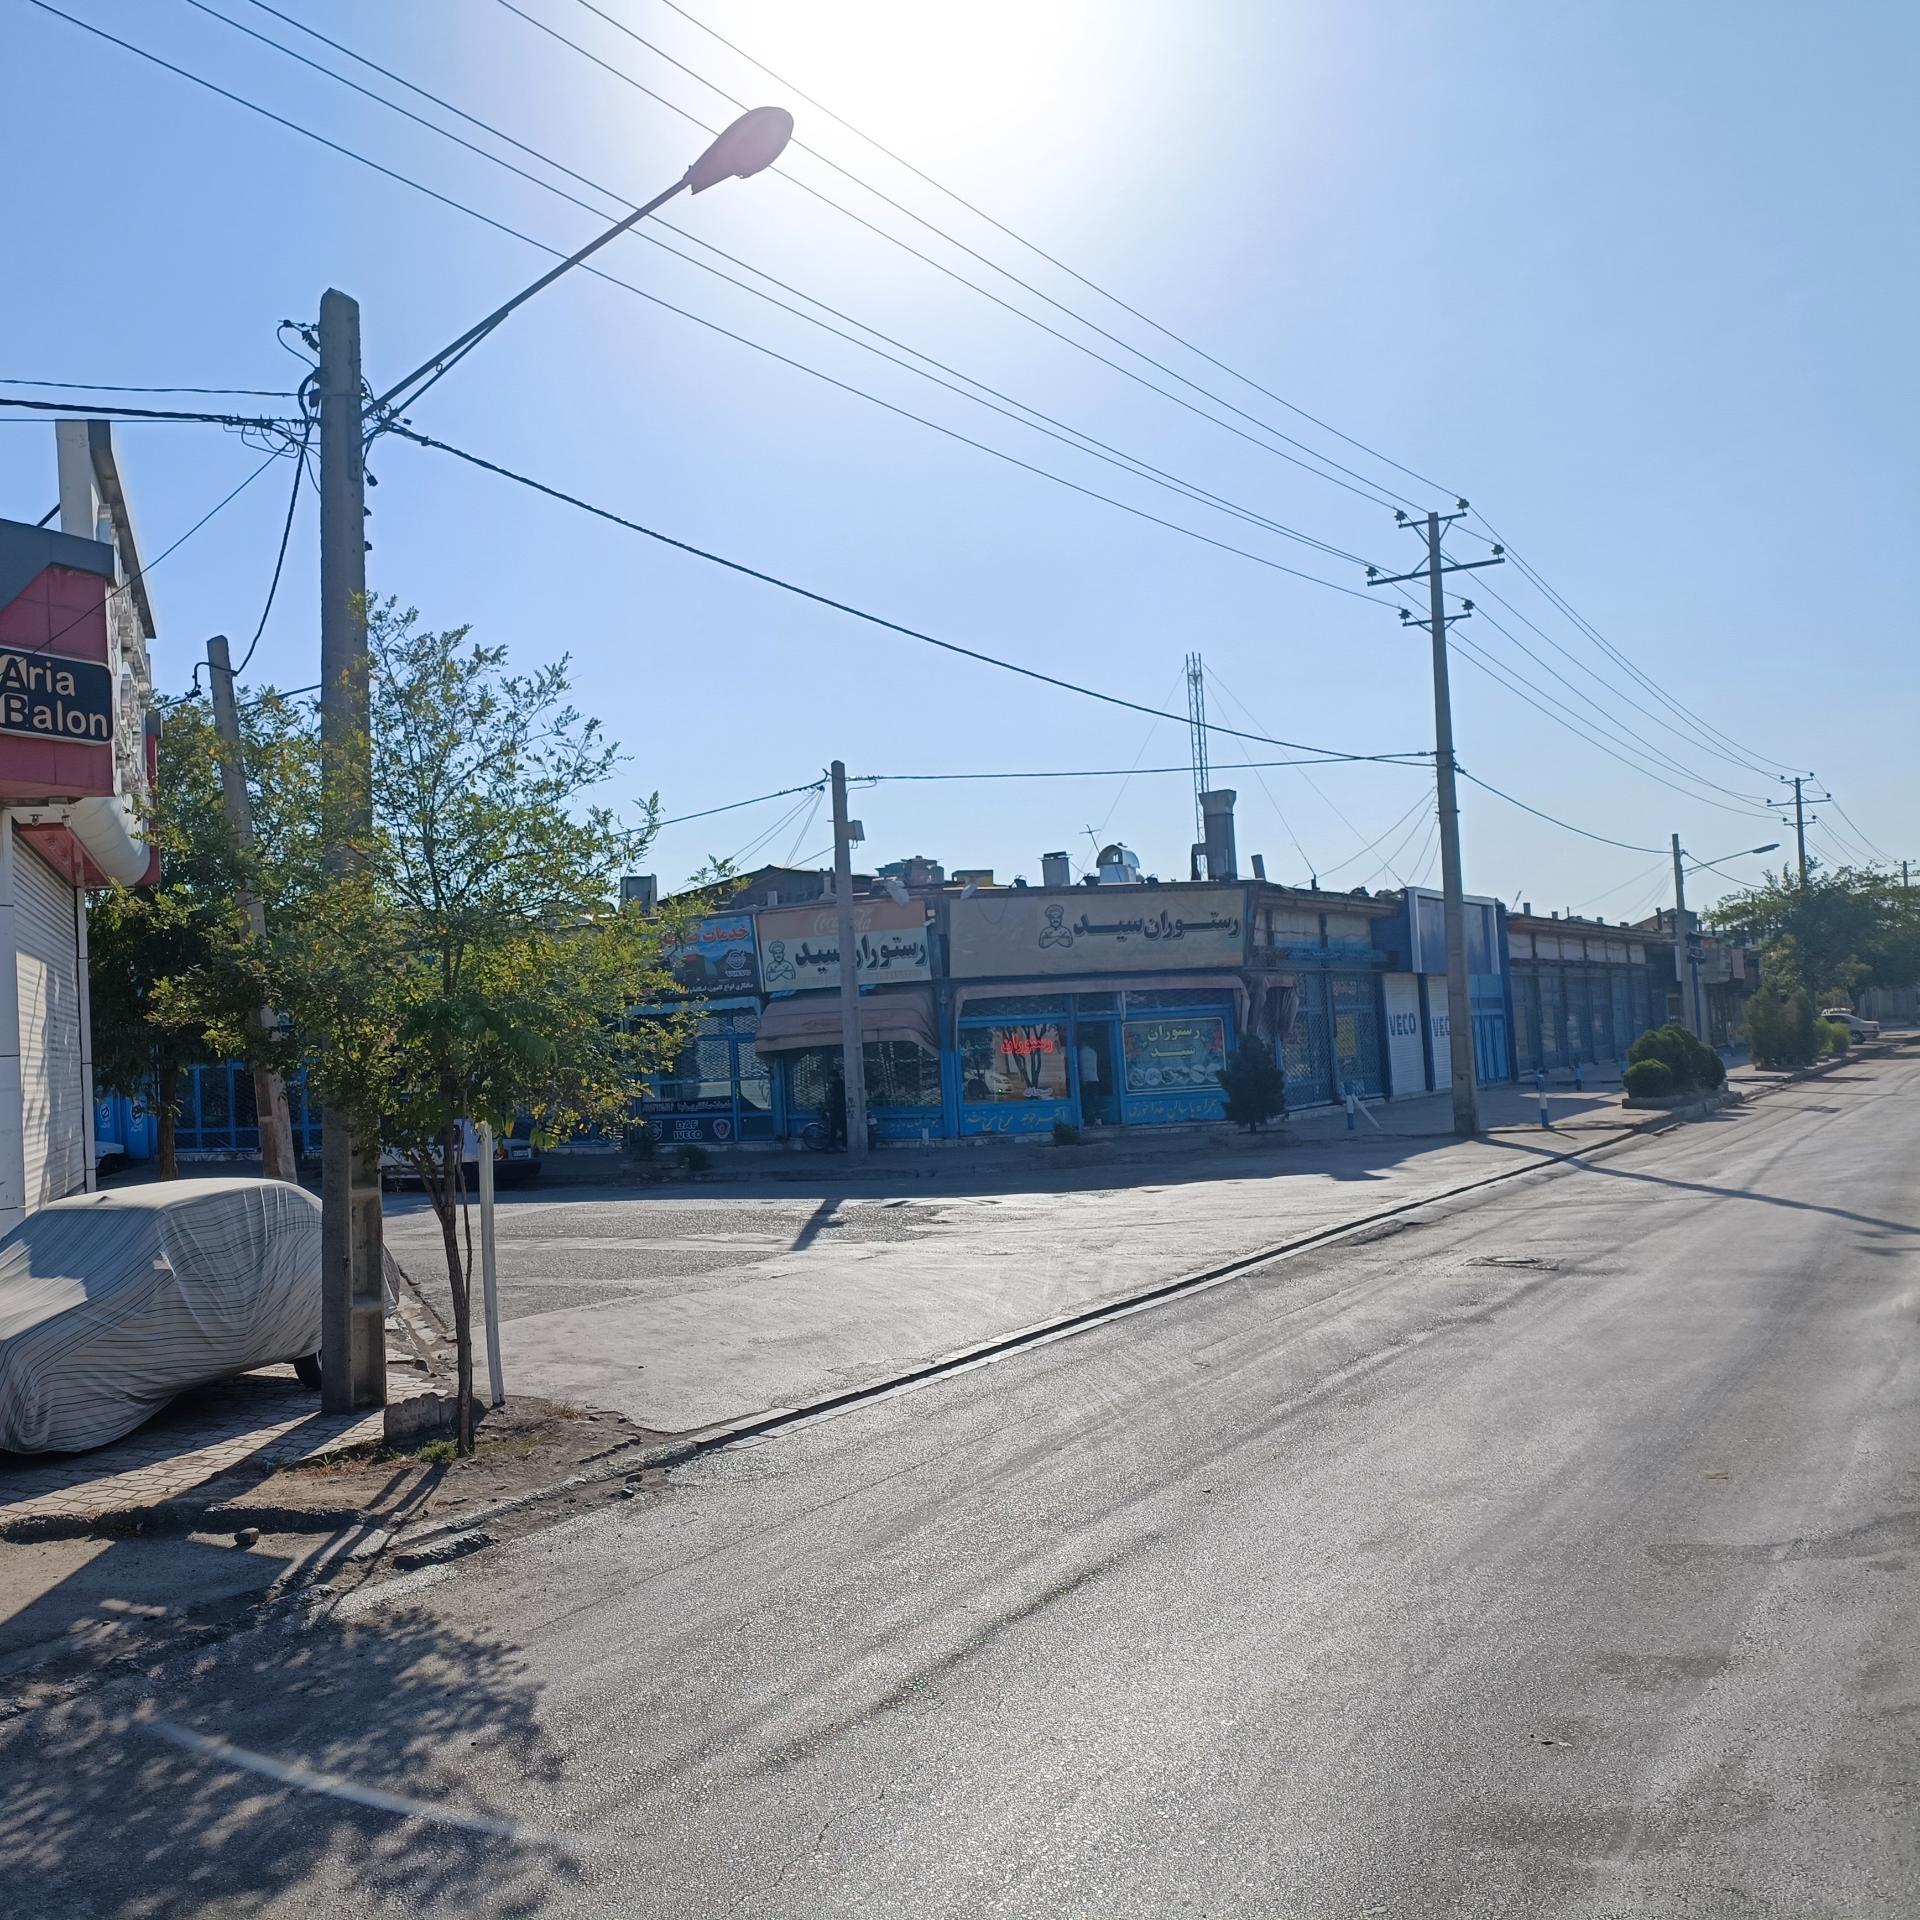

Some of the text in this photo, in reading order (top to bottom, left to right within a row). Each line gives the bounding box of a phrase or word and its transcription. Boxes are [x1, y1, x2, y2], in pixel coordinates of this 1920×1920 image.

[0, 654, 76, 697] Aria
[1, 692, 108, 738] Balon
[702, 926, 749, 943] خدمات
[1073, 909, 1240, 943] رستوران سید
[1147, 1024, 1200, 1041] رستوران
[1431, 1015, 1451, 1037] VEC
[1000, 1034, 1054, 1055] رستوران
[673, 1129, 703, 1140] IVECO
[675, 1119, 699, 1130] DAF
